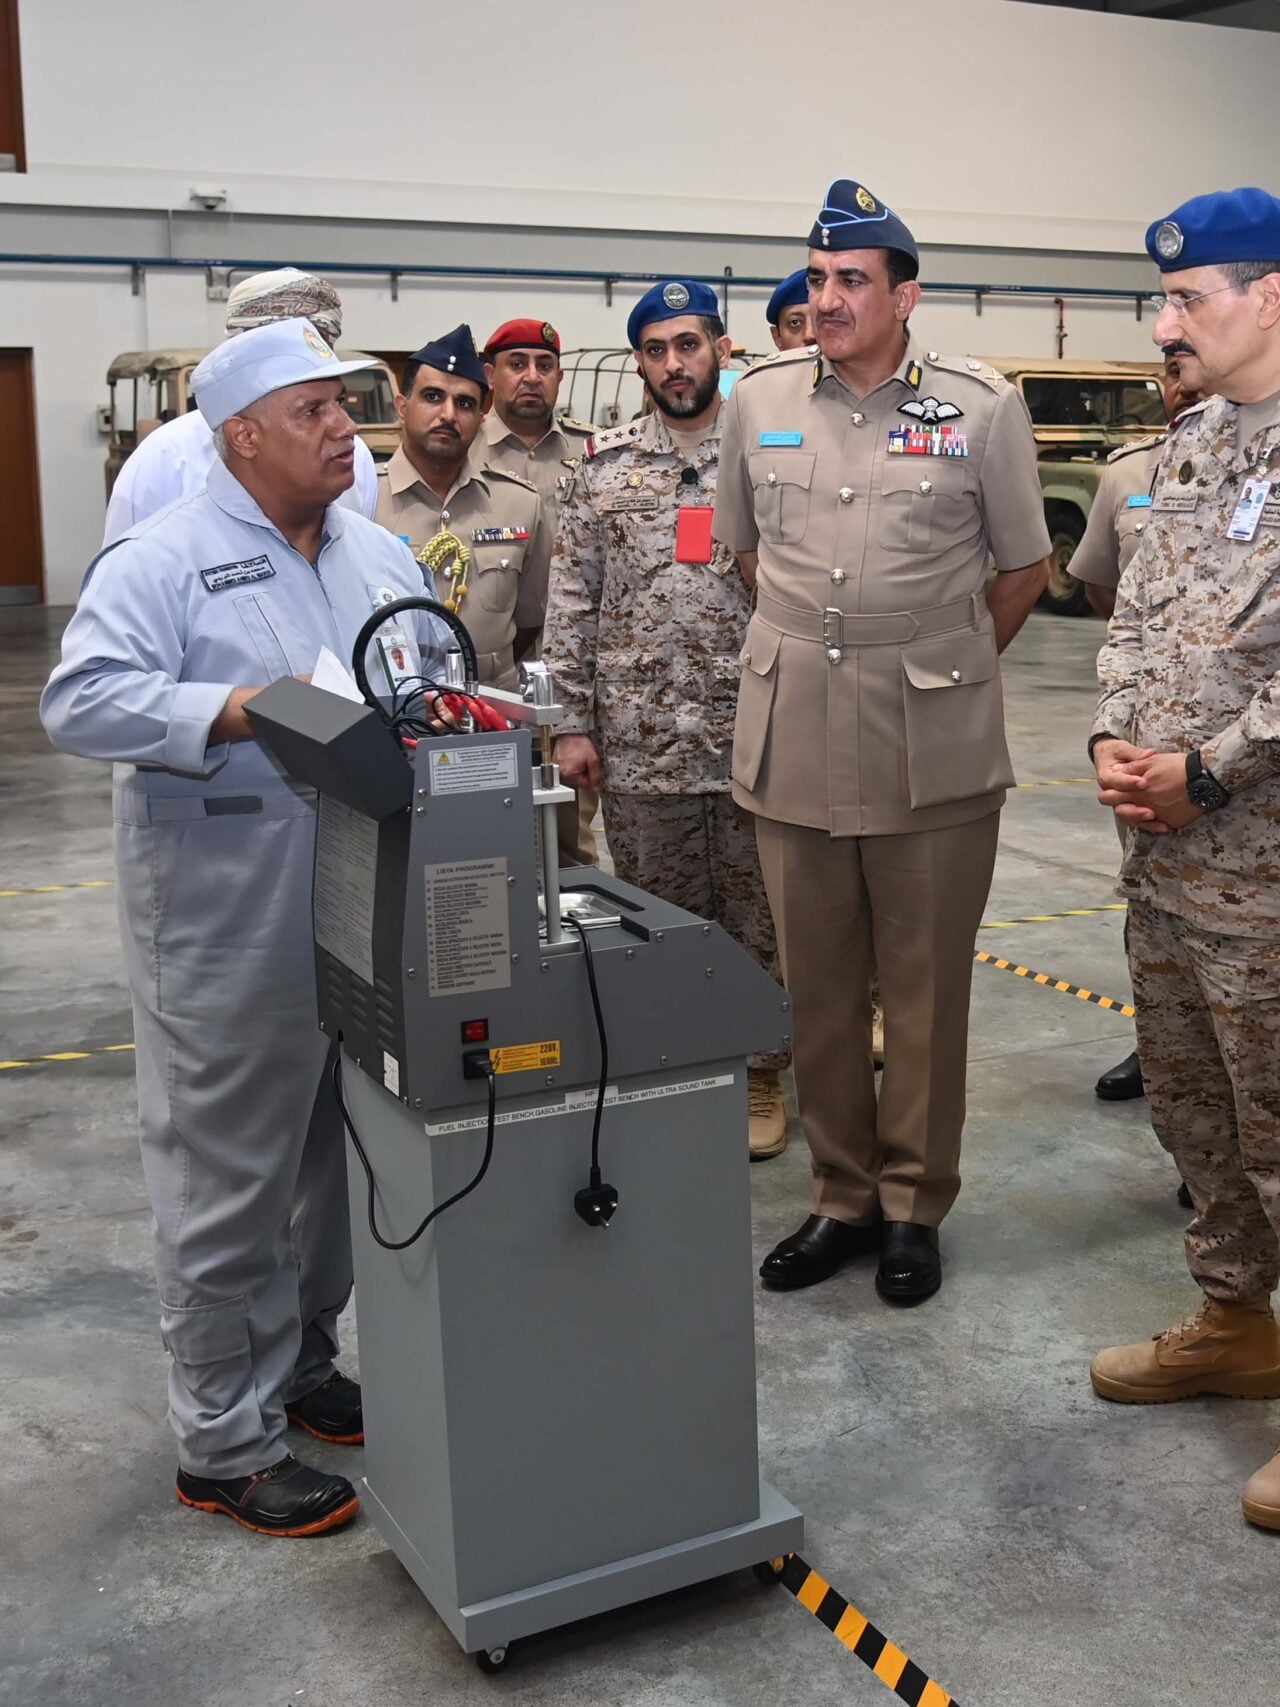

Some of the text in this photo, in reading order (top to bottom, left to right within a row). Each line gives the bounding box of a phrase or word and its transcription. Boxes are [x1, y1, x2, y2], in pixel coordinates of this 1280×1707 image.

[438, 1124, 456, 1133] FUEL
[458, 1118, 489, 1130] INJECTIO
[604, 1096, 617, 1105] EST
[619, 1093, 639, 1102] BENCH
[641, 1089, 656, 1098] WITH
[657, 1086, 677, 1096] ULTRA
[678, 1081, 700, 1091] SOUND
[701, 1078, 717, 1088] TANK
